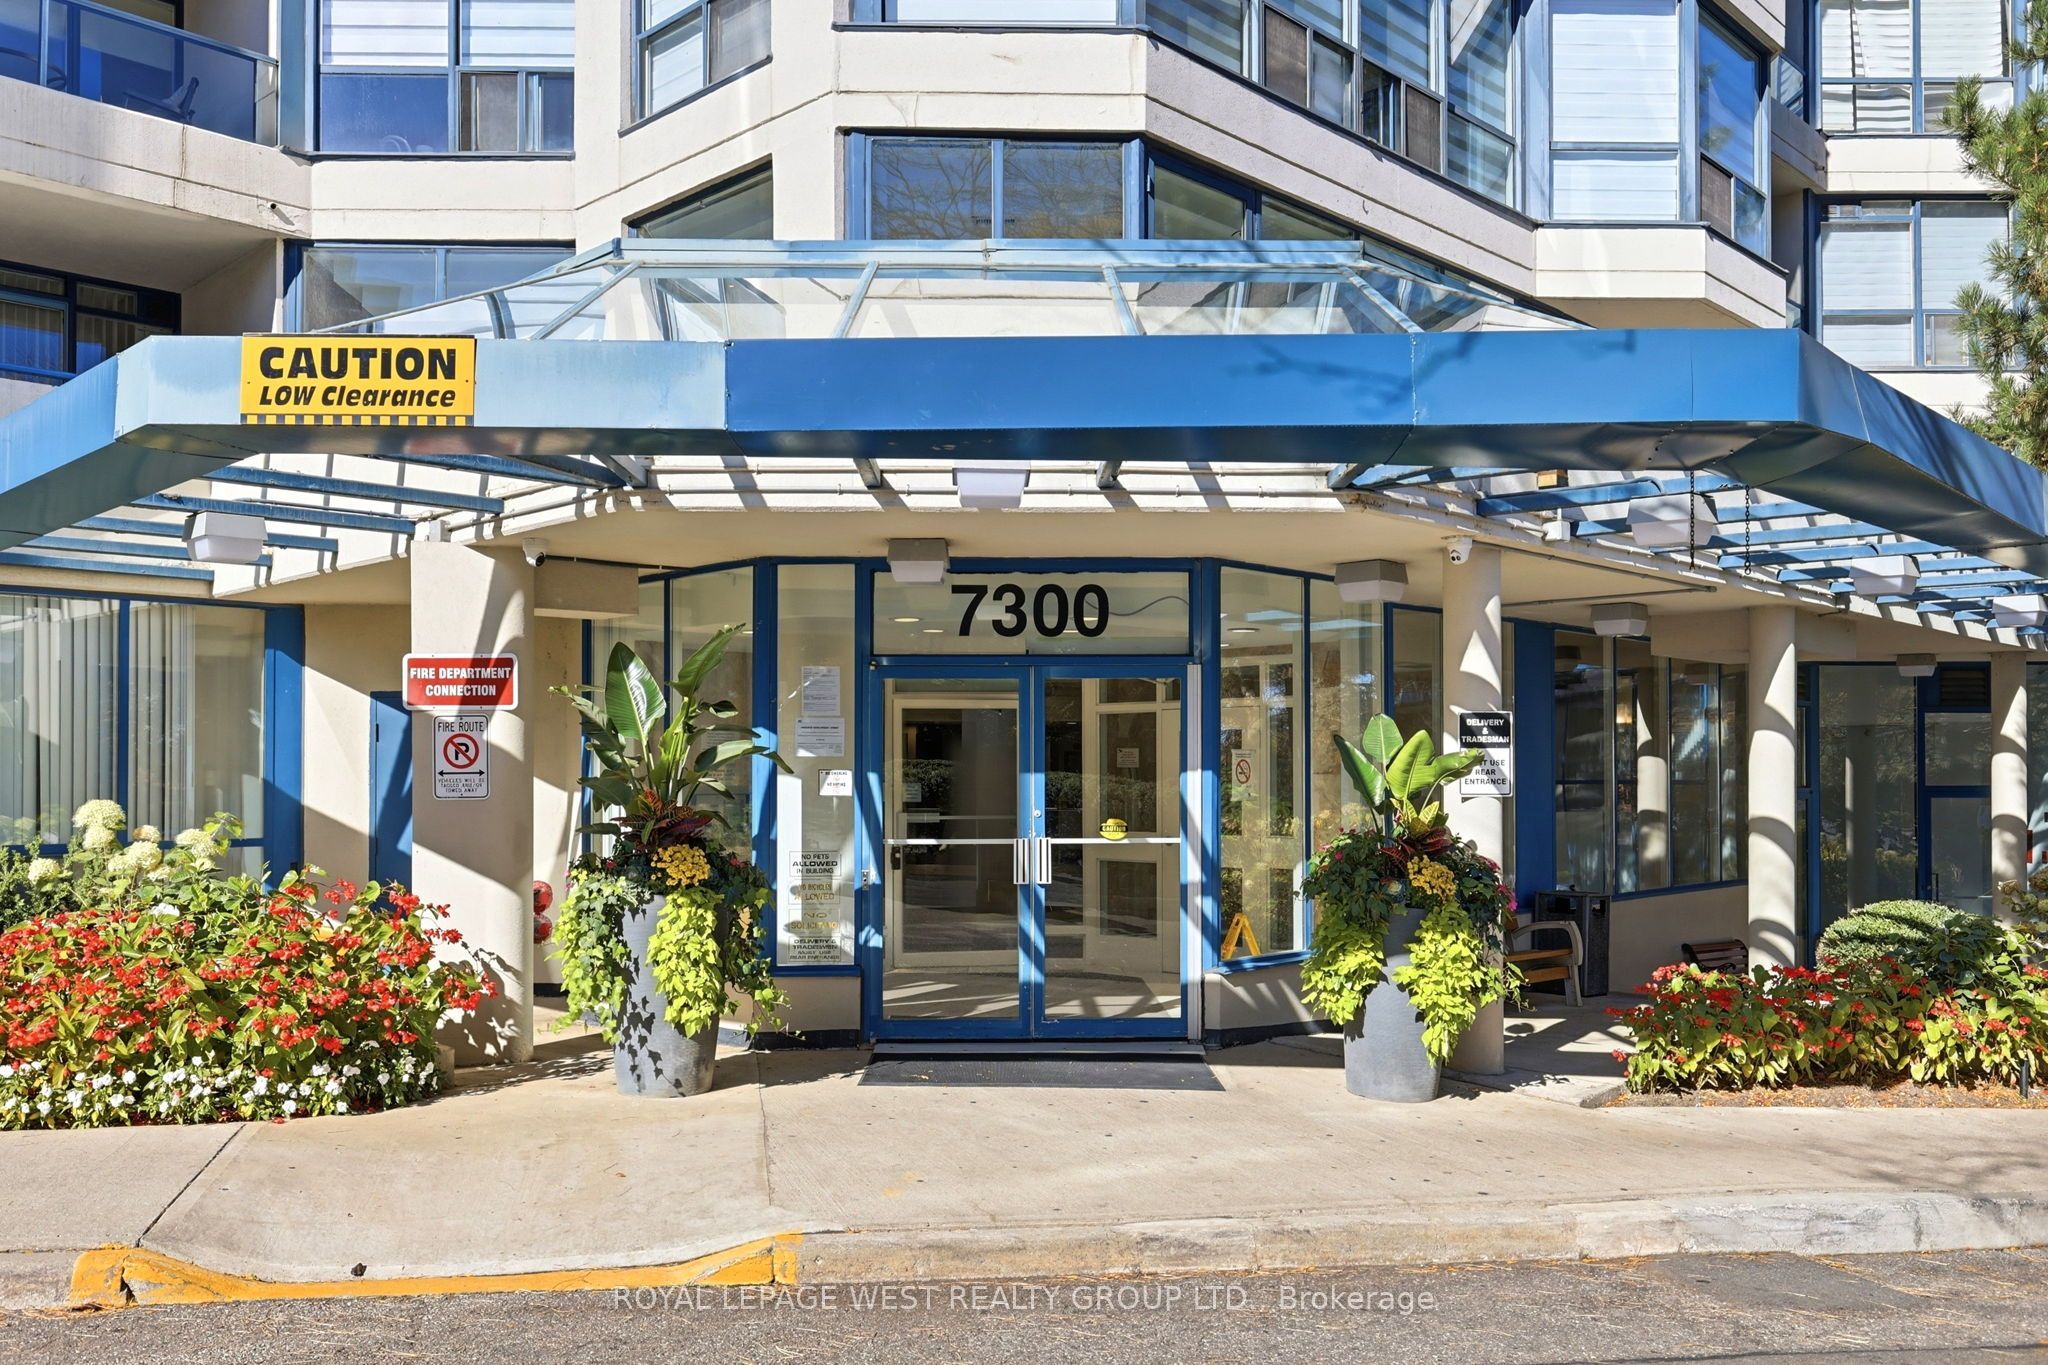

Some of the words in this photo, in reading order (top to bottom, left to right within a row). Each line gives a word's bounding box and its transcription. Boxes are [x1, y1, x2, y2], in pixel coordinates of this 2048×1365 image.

[259, 346, 457, 380] CAUTION
[259, 386, 316, 406] LOW
[321, 385, 456, 407] Clearance
[951, 583, 1110, 638] 7300
[410, 667, 436, 679] FIRE
[438, 667, 512, 679] DEPARTMENT
[425, 684, 497, 696] CONNECTION
[437, 721, 455, 732] FIRE
[458, 721, 485, 732] ROUTE
[1466, 718, 1505, 726] DELIVERY
[1482, 727, 1489, 735] &
[1461, 735, 1510, 743] TRADESMAN
[1489, 759, 1505, 767] USE
